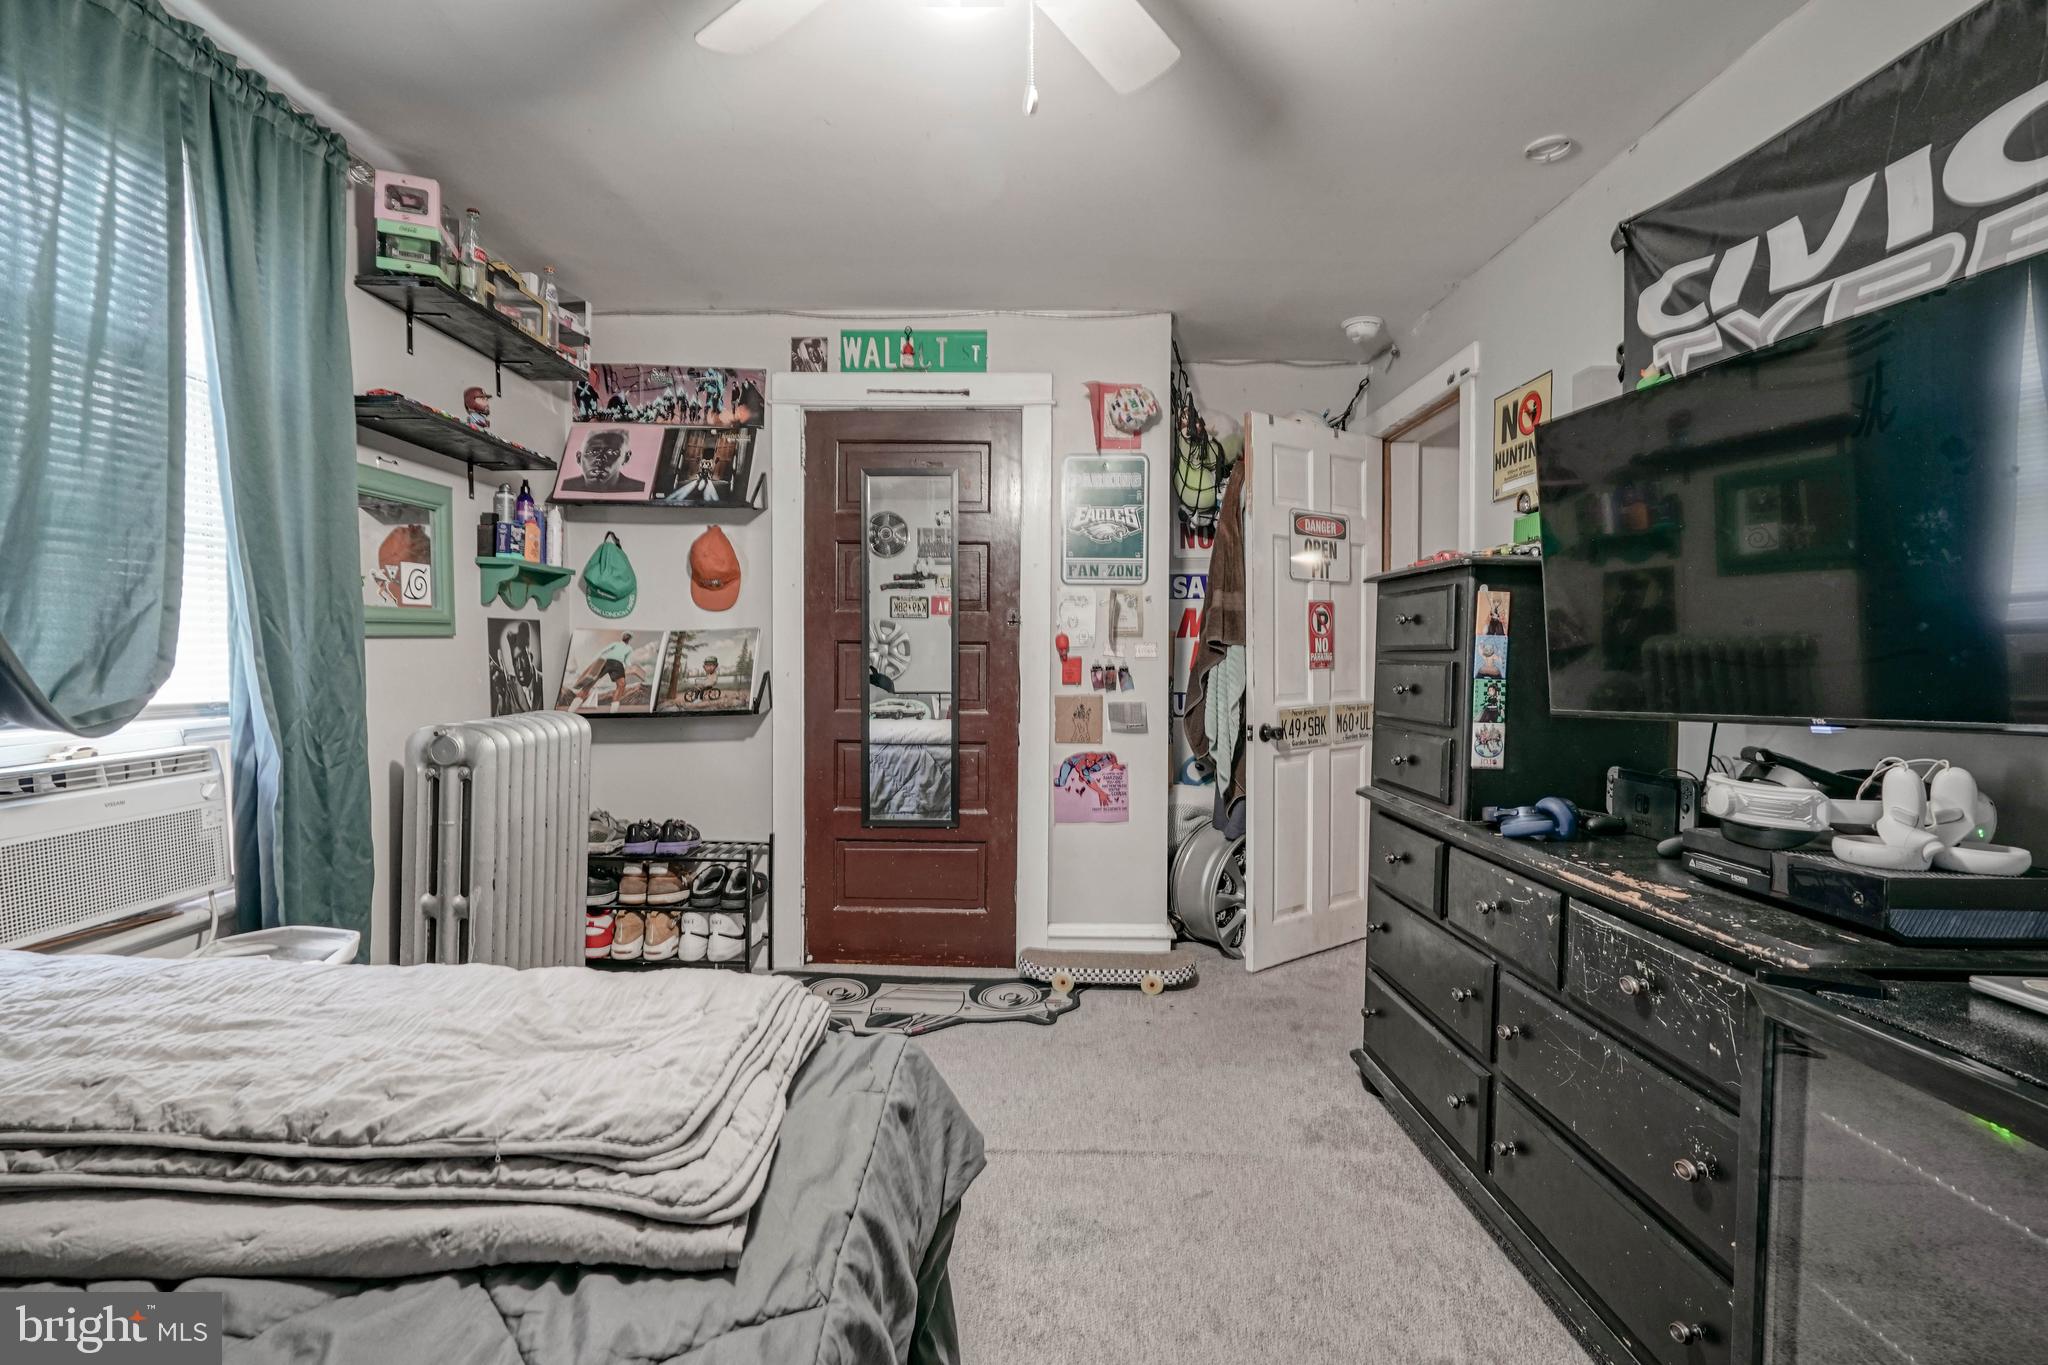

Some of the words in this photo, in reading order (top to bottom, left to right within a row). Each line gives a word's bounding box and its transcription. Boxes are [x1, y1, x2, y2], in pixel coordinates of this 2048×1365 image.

[1502, 391, 1542, 444] NO
[1495, 439, 1536, 471] HUNTIN
[1075, 506, 1139, 528] EAGLES
[1304, 519, 1337, 535] DANGER
[1304, 538, 1337, 559] OPEN
[1068, 564, 1099, 577] FAN
[1108, 564, 1143, 577] ZONE
[1314, 637, 1329, 652] NO
[1310, 652, 1333, 661] PARKING
[1281, 718, 1302, 740] K49
[1308, 715, 1327, 736] SBK
[1336, 713, 1354, 733] M60
